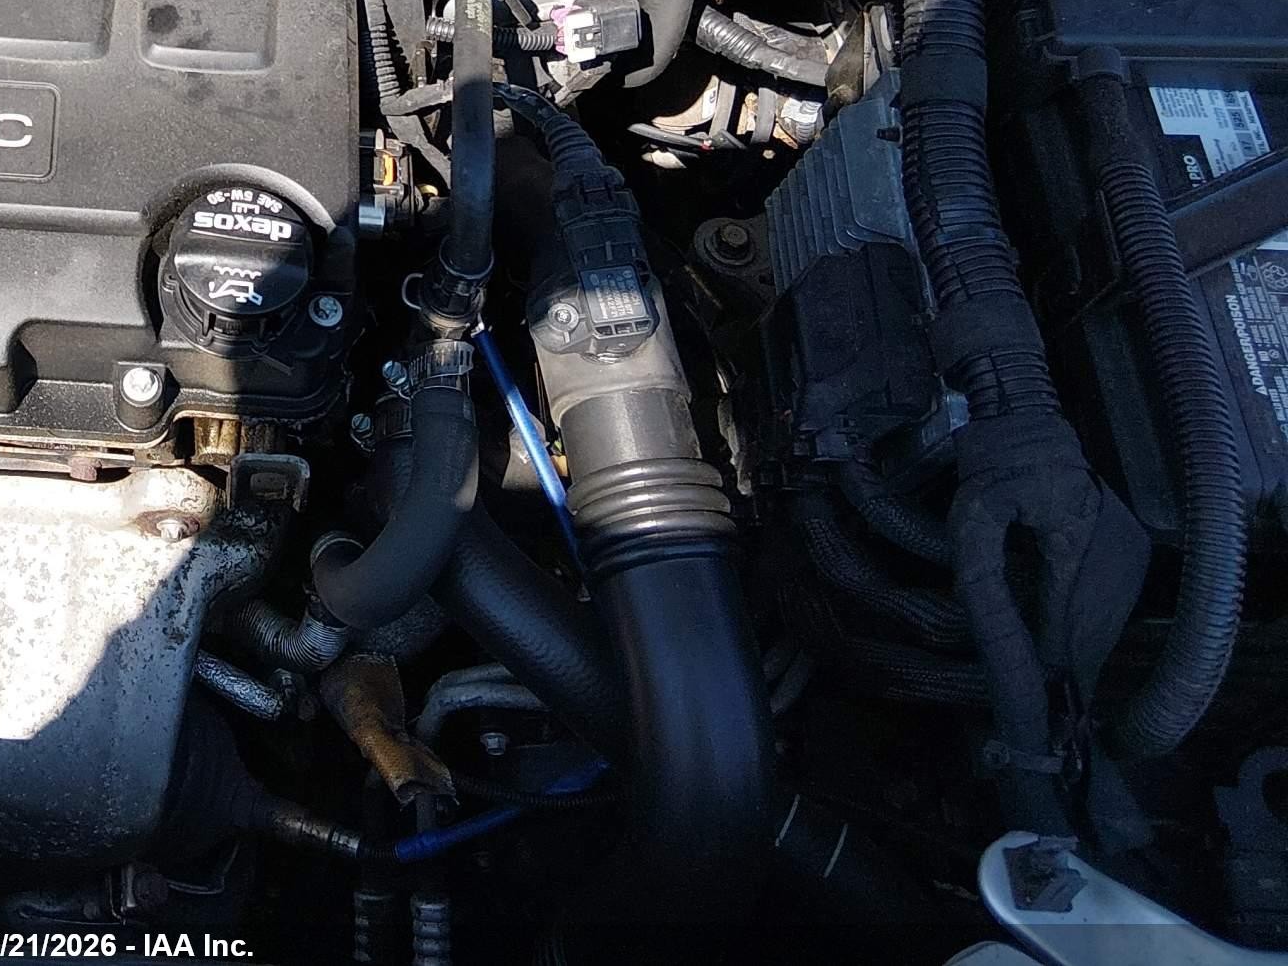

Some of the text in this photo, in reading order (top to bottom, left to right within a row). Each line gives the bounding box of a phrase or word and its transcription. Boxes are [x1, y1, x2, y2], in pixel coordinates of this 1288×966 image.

[1183, 154, 1202, 181] PRO
[206, 189, 283, 214] SAE 5W-30
[192, 211, 292, 241] dexos
